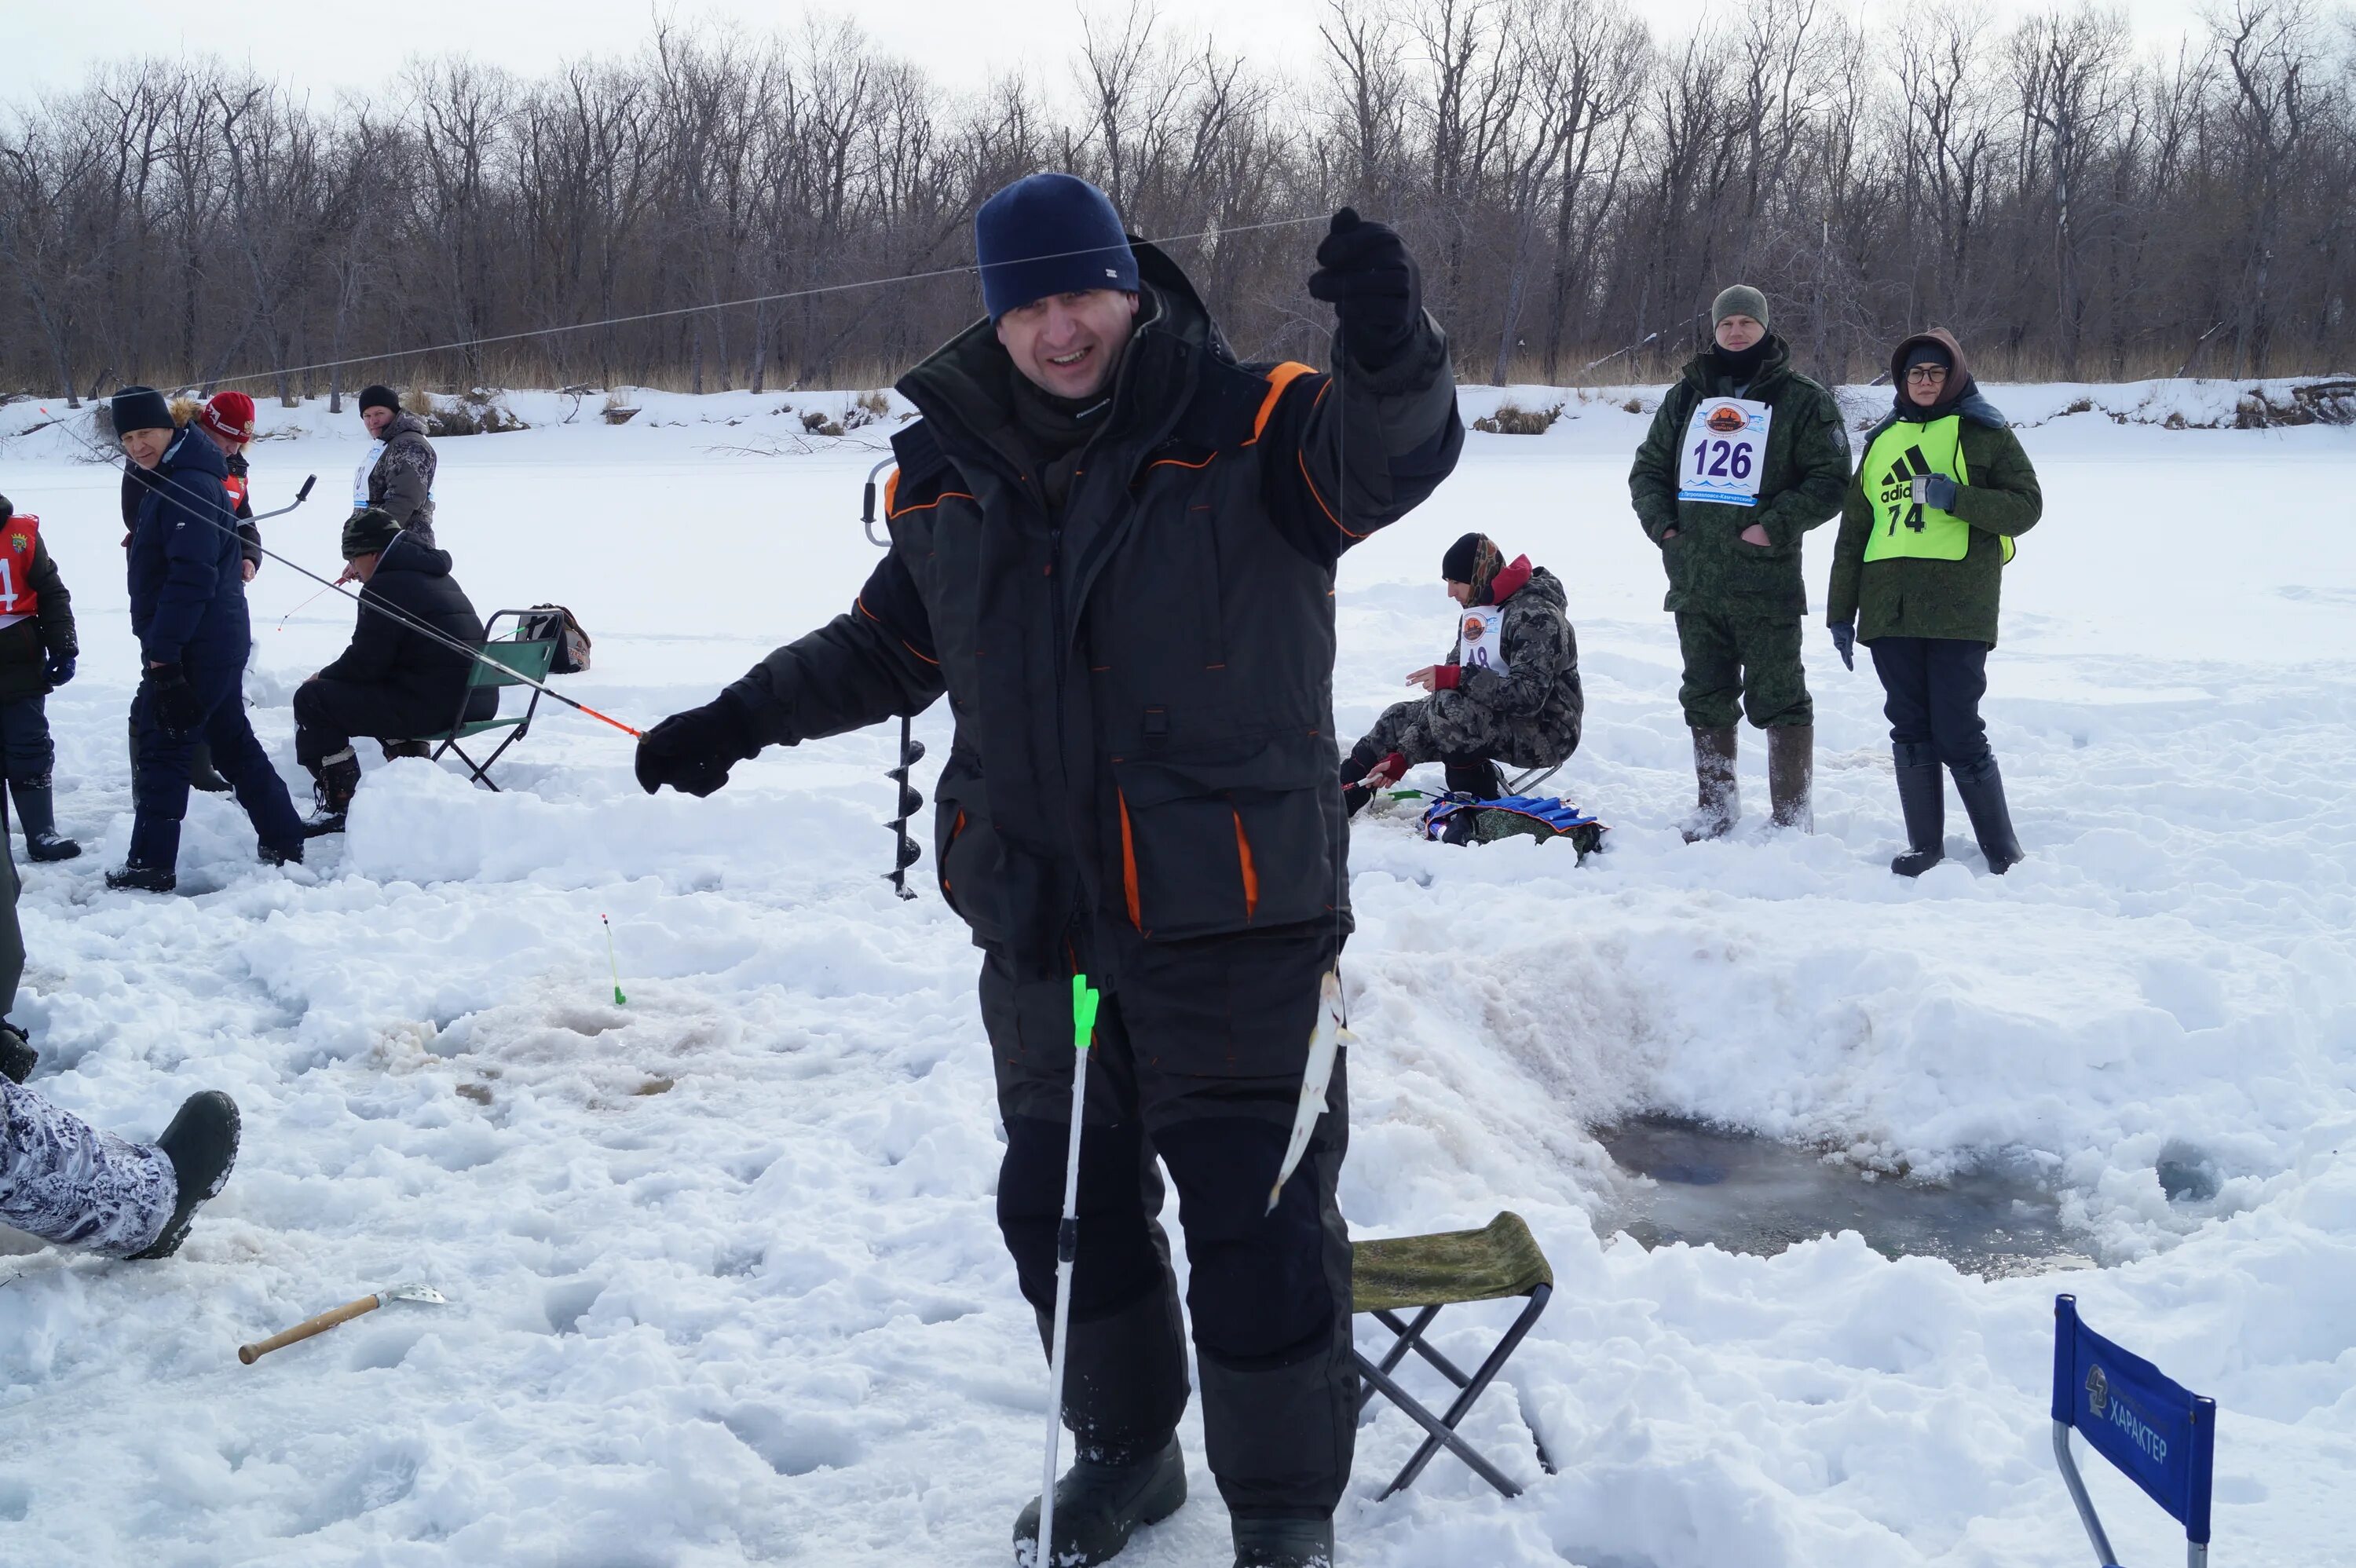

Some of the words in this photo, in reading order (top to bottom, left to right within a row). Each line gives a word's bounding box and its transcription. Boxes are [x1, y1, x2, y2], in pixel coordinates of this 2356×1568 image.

[1694, 440, 1753, 479] 126
[1881, 482, 1912, 503] adid
[1887, 503, 1926, 537] 74
[2109, 1396, 2167, 1465] ХАРАКТЕР
